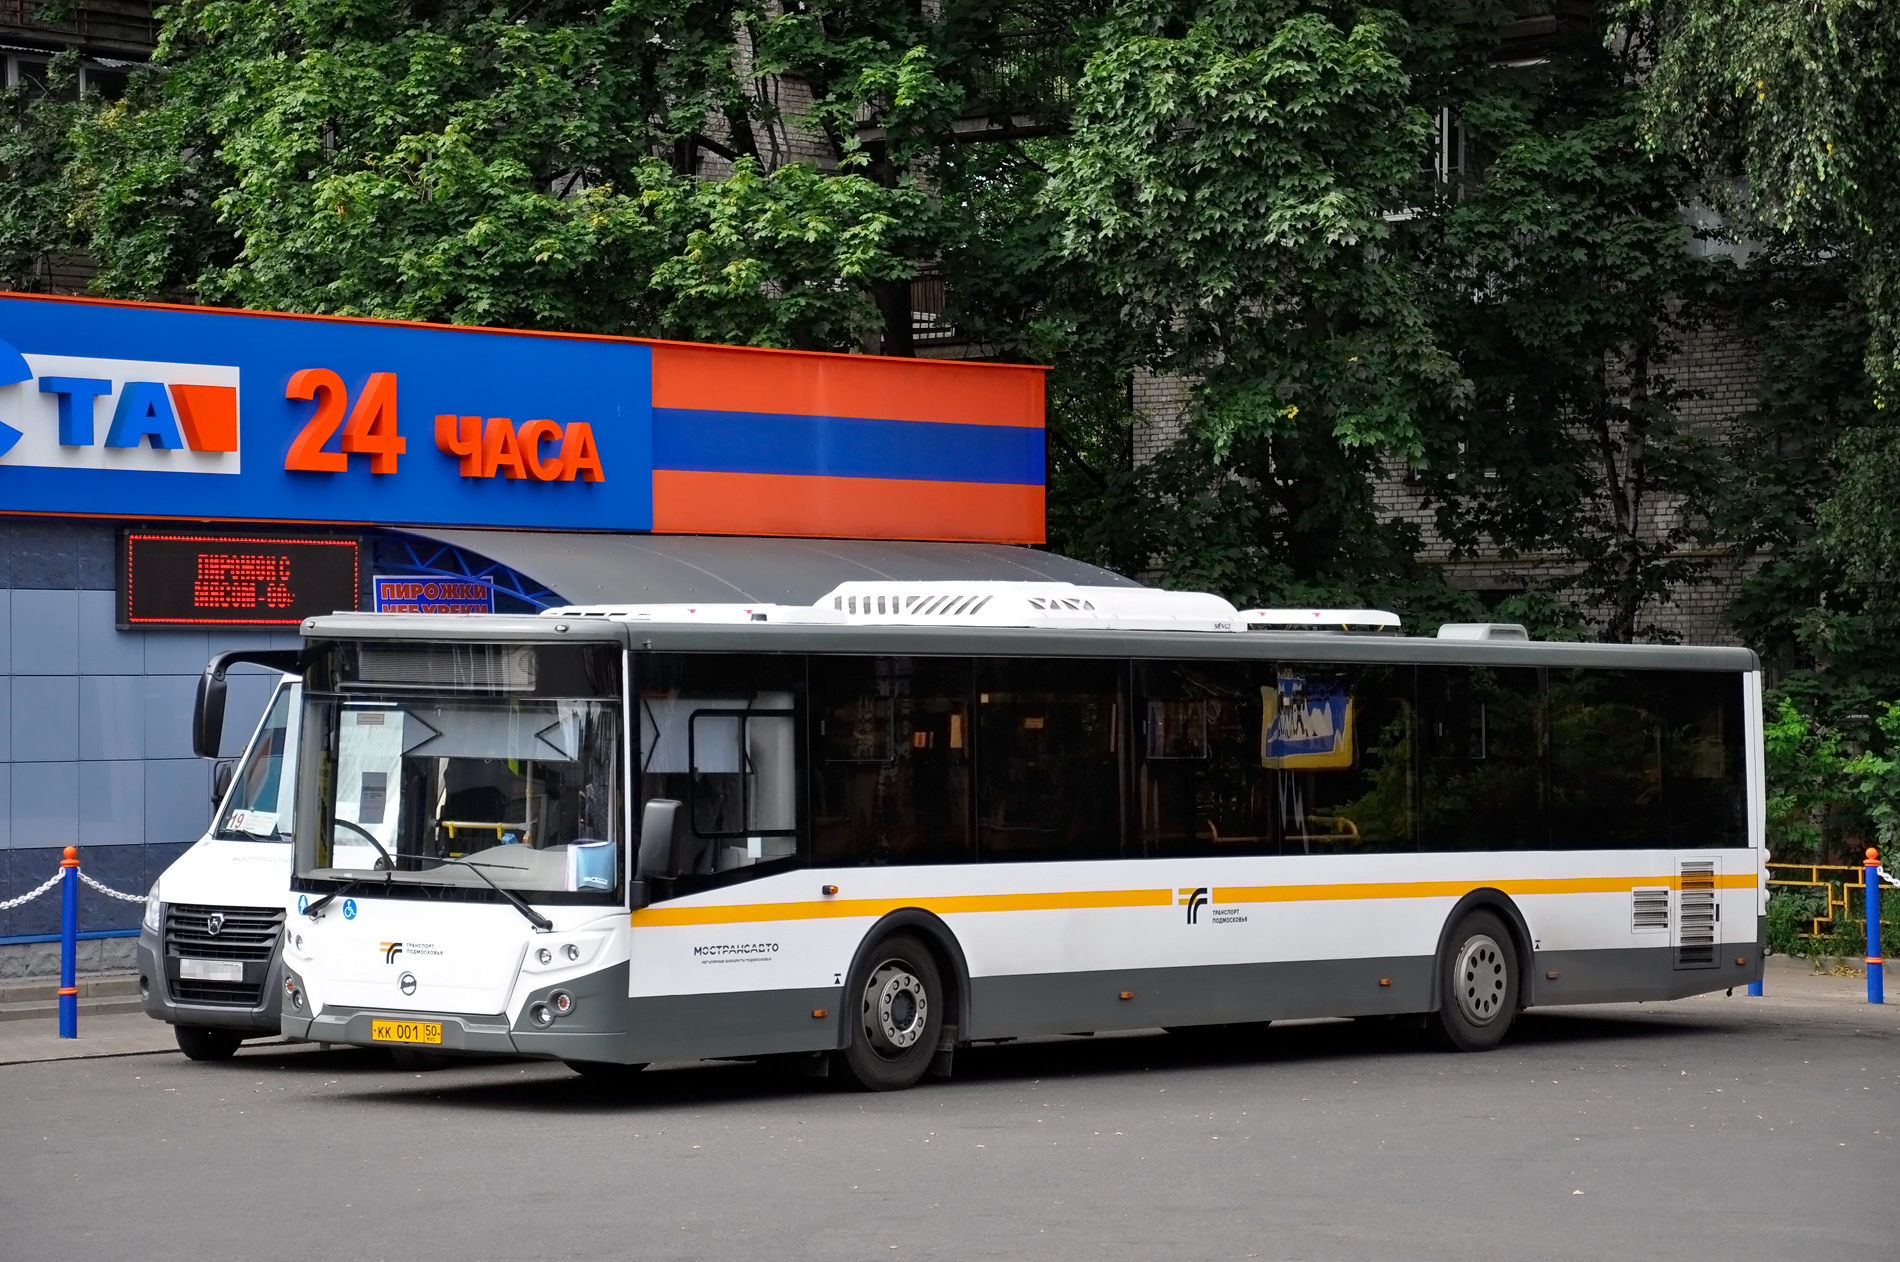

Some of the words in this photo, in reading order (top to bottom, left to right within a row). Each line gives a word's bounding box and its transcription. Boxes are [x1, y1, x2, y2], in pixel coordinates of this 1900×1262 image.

[284, 368, 407, 474] 24
[434, 414, 606, 482] ЧАСА
[381, 582, 488, 600] ПИРОЖКИ
[230, 813, 245, 829] 19
[693, 943, 779, 956] МОСТРАНСАВТО
[377, 1026, 391, 1039] КК
[396, 1024, 418, 1040] 001
[425, 1025, 437, 1036] 50
